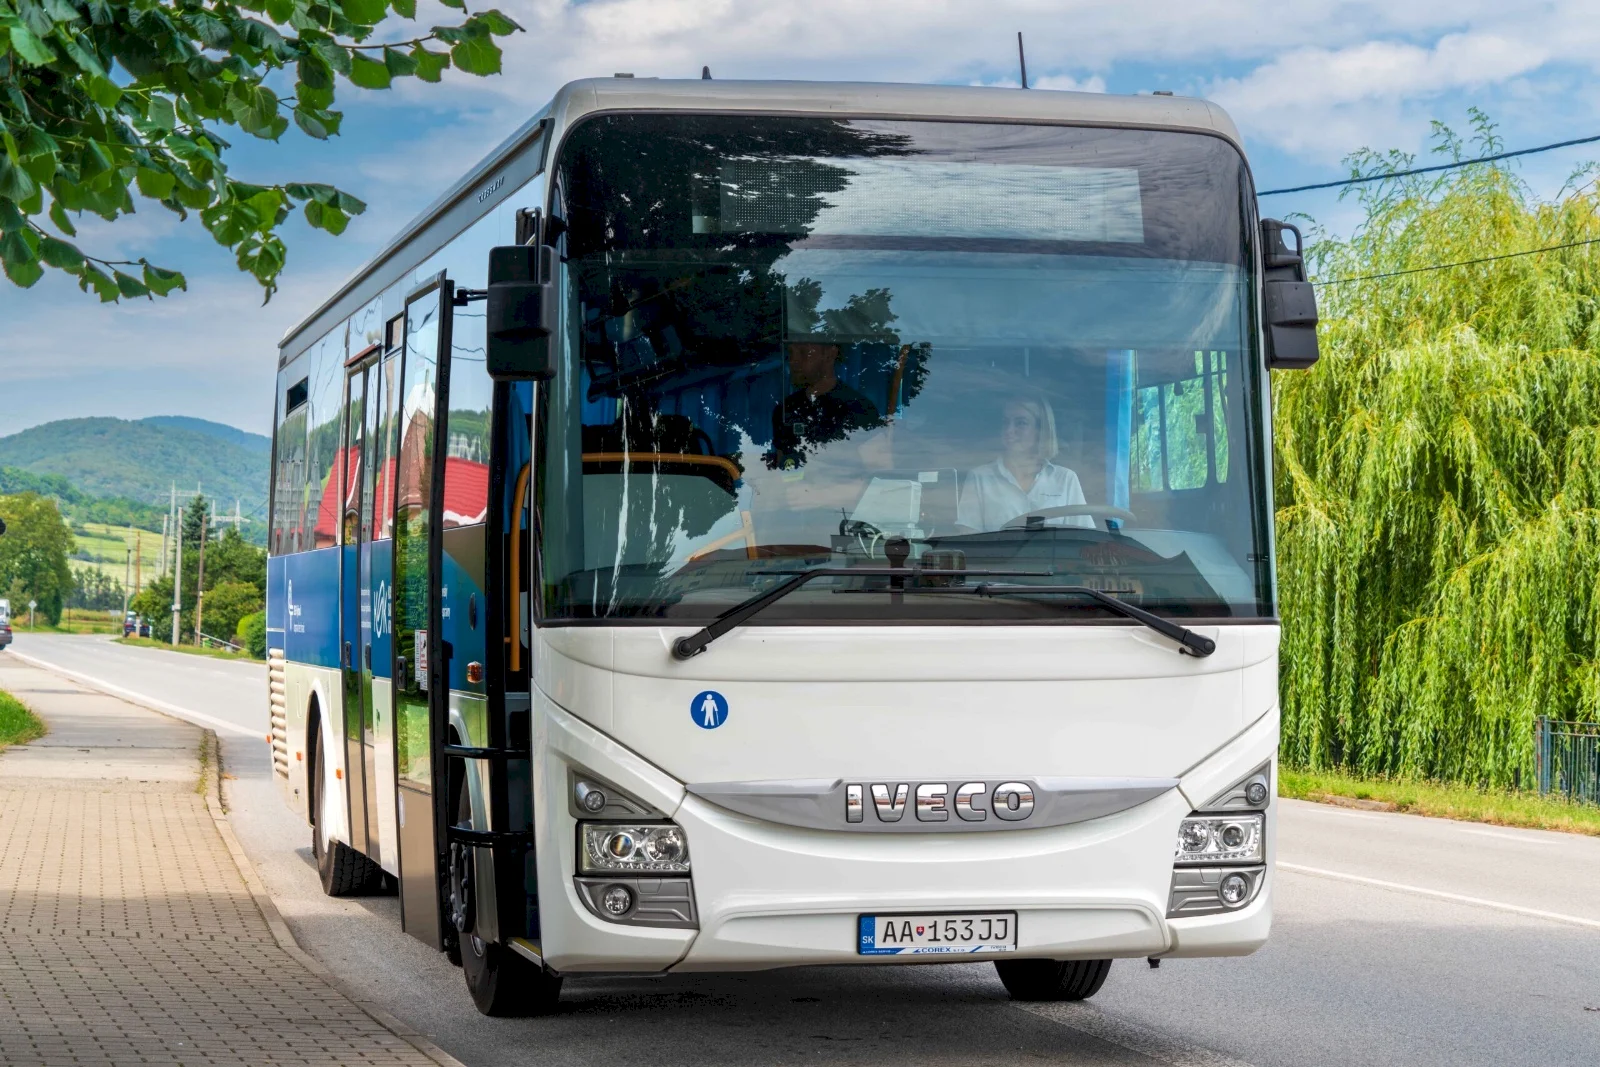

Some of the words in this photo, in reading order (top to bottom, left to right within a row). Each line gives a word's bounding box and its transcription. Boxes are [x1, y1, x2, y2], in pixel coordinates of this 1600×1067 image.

[846, 781, 1035, 823] IVECO
[862, 935, 875, 944] SK
[882, 920, 914, 943] AA
[928, 919, 1008, 942] 153JJ
